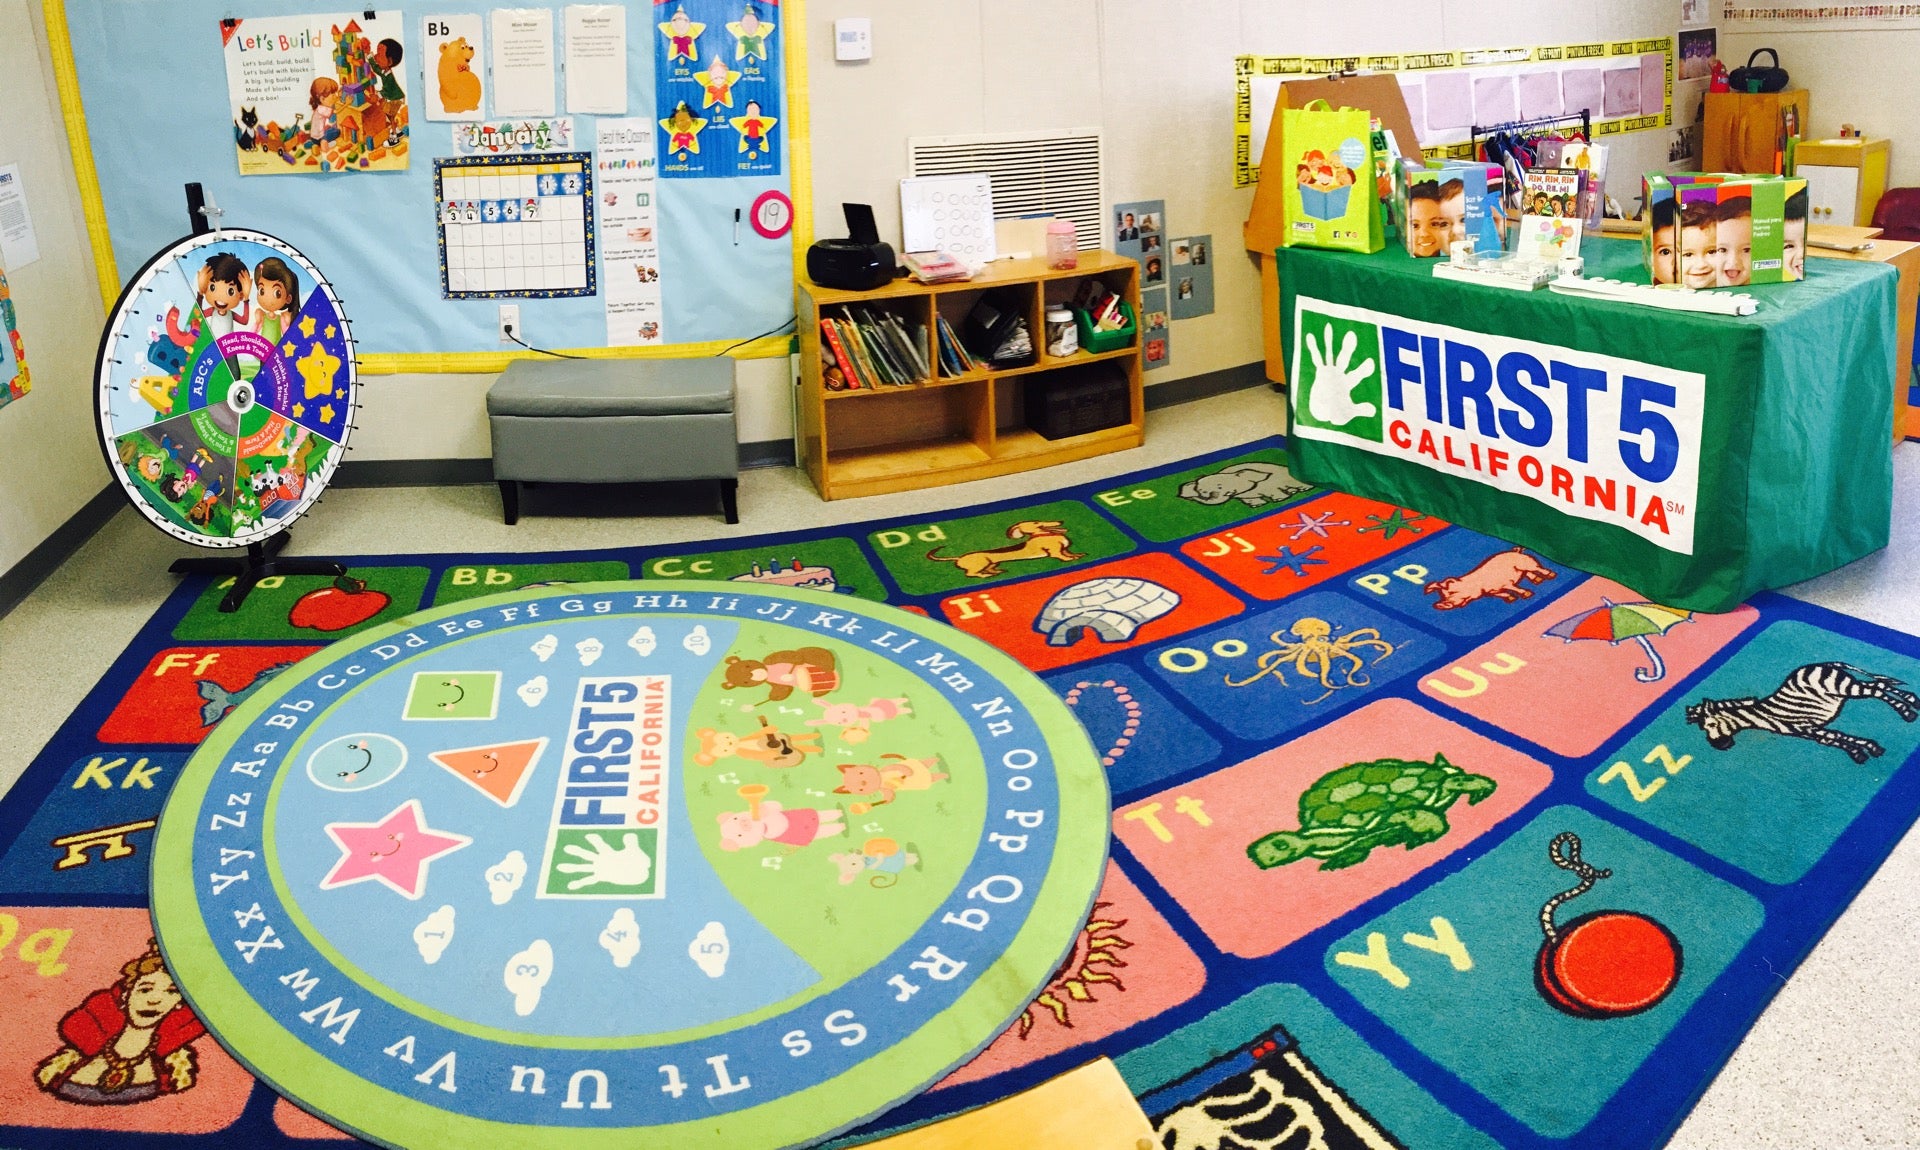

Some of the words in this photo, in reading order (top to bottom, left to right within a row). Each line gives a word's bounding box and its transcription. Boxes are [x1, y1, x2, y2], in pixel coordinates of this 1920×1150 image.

[238, 34, 273, 52] Let's
[279, 29, 321, 51] Build
[1567, 46, 1587, 58] PINTURA
[1587, 45, 1604, 57] FRESCA
[469, 127, 551, 150] January
[569, 180, 574, 188] 2
[1528, 175, 1543, 183] RIN,
[1545, 175, 1560, 183] RIN,
[1561, 175, 1574, 183] RIN
[451, 212, 456, 220] 3
[489, 207, 493, 215] 5
[508, 206, 512, 214] 6
[529, 210, 534, 218] 7
[763, 202, 781, 226] 19
[221, 335, 239, 347] Head,
[241, 334, 269, 352] Shoulders,
[226, 345, 245, 353] Knees
[253, 346, 265, 357] Toes
[194, 357, 213, 396] ABC's
[272, 365, 283, 384] Little
[273, 352, 286, 382] Twinkle,
[1381, 325, 1608, 464] FIRST
[1618, 375, 1680, 484] 5
[196, 417, 210, 441] Happy
[272, 422, 281, 435] Old
[1389, 420, 1670, 535] CALIFORNIA
[1666, 500, 1685, 516] SM
[1098, 487, 1158, 509] Ee
[876, 525, 946, 550] Dd
[1202, 532, 1256, 558] Jj
[452, 568, 513, 586] Bb
[653, 557, 714, 577] Cc
[1355, 560, 1430, 597] Pp
[499, 604, 540, 622] Ff
[560, 598, 613, 614] Gg
[633, 593, 689, 609] Hh
[706, 596, 740, 611] Ii
[757, 602, 798, 622] Jj
[948, 593, 1001, 620] Ii
[437, 618, 483, 637] Ee
[808, 612, 864, 636] Kk
[371, 632, 429, 661] Dd
[690, 635, 705, 647] 10
[871, 630, 907, 654] Ll
[154, 653, 220, 677] Ff
[1158, 639, 1249, 674] Oo
[317, 663, 367, 691] Cc
[916, 653, 975, 695] Mm
[1426, 652, 1527, 700] Uu
[582, 682, 638, 704] 5
[266, 698, 315, 730] Bb
[971, 696, 1016, 738] Nn
[231, 740, 279, 779] Aa
[636, 680, 665, 825] CALIFORNIA
[72, 757, 163, 790] Kk
[559, 707, 635, 825] FIRST
[1003, 749, 1038, 792] Oo
[1597, 743, 1693, 803] Zz
[210, 792, 252, 832] Zz
[1123, 798, 1214, 844] Tt
[988, 809, 1044, 853] Pp
[212, 846, 256, 896] Yy
[494, 870, 514, 883] 2
[941, 874, 1024, 934] Qq
[234, 903, 284, 964] Xx
[423, 929, 446, 940] 1
[606, 929, 628, 943] 4
[701, 941, 724, 955] 5
[1334, 915, 1476, 990] Yy
[515, 963, 540, 978] 3
[886, 945, 968, 1003] Rr
[279, 968, 362, 1045] Ww
[781, 1009, 868, 1058] Ss
[383, 1035, 459, 1094] Vv
[658, 1054, 751, 1100] Tt
[510, 1064, 613, 1109] Uu
